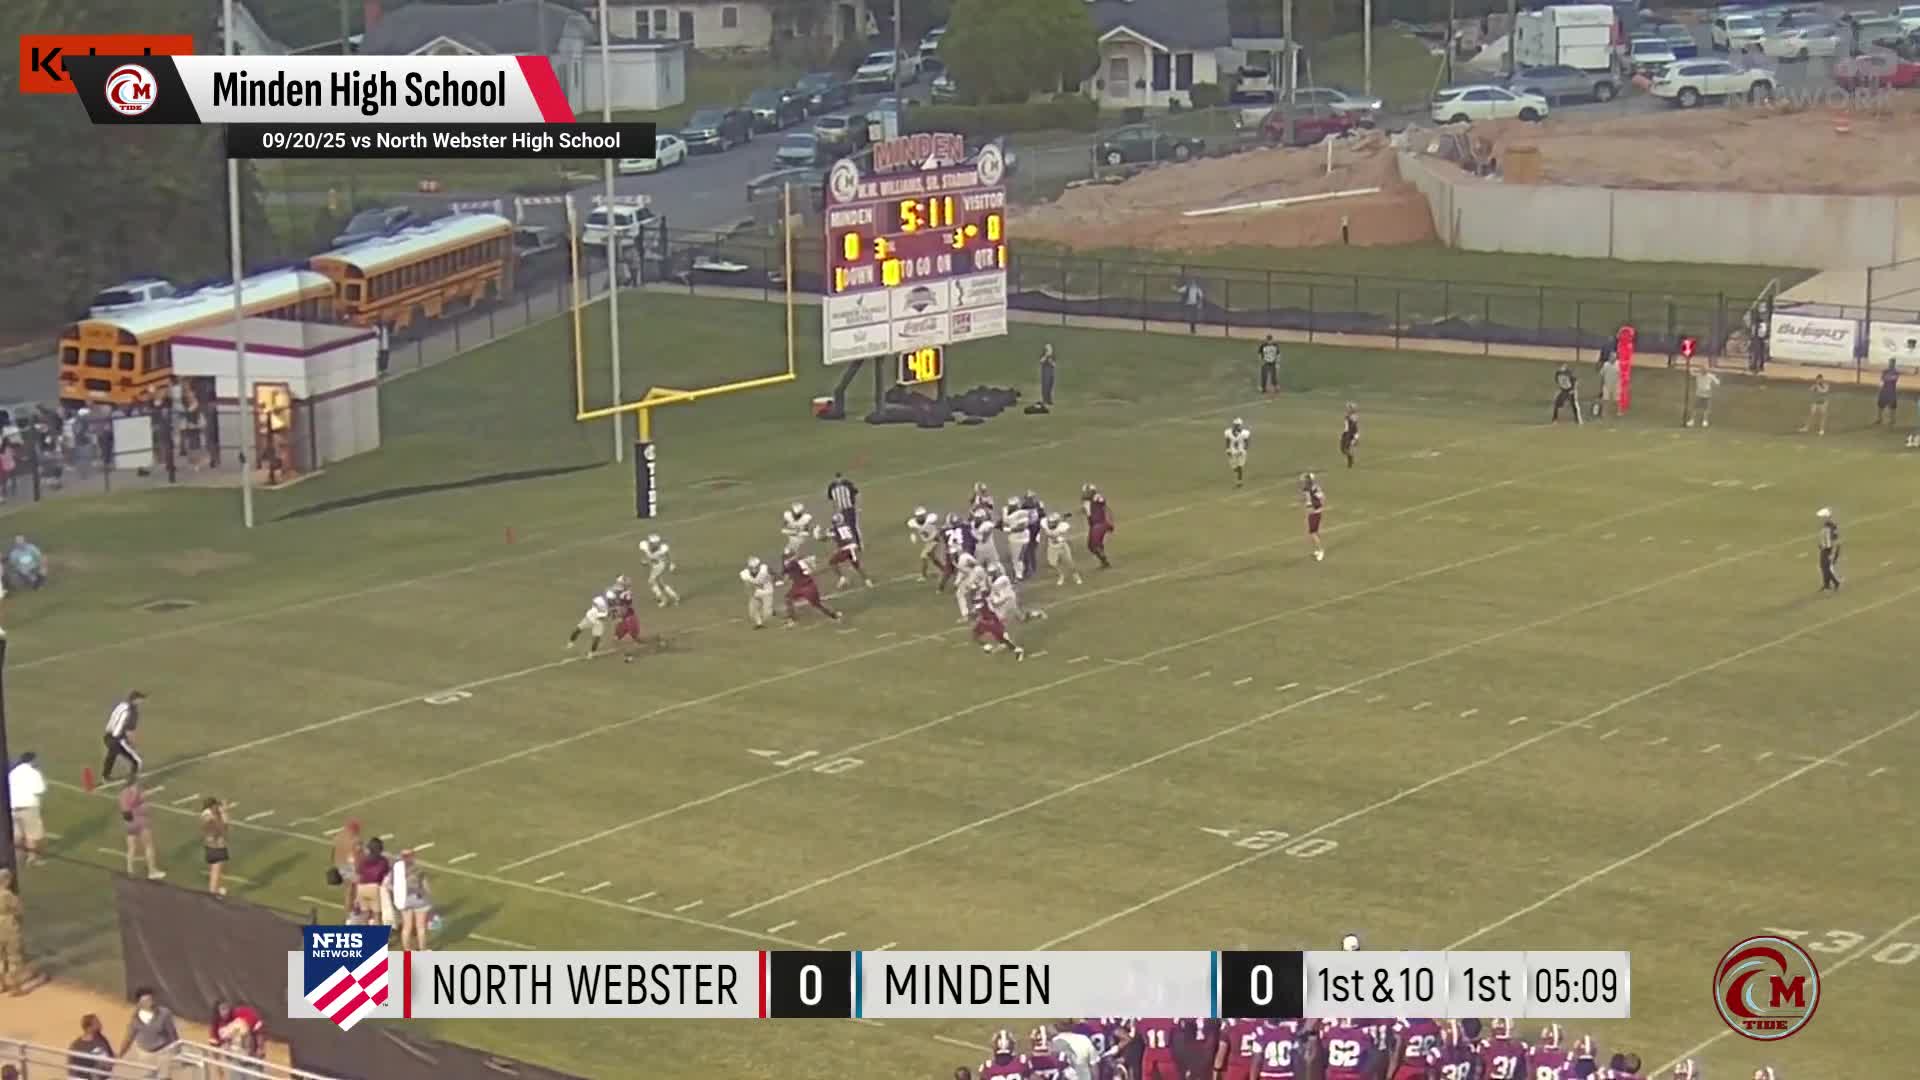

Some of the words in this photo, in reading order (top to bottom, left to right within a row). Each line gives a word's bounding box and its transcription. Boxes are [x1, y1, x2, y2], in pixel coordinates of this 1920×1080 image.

[874, 133, 964, 172] MINDEN
[901, 196, 954, 234] 5:11
[962, 192, 1005, 211] VISITOR
[830, 208, 873, 228] MINDEN
[987, 214, 1002, 242] 0
[844, 232, 861, 261] 0
[974, 248, 994, 270] QTR
[900, 258, 914, 279] TO
[916, 255, 931, 277] GO
[937, 253, 952, 274] ON
[907, 347, 936, 381] 40
[1232, 829, 1340, 859] 20
[1147, 1029, 1166, 1049] 11
[1263, 1039, 1293, 1067] 40
[1328, 1038, 1361, 1067] 62
